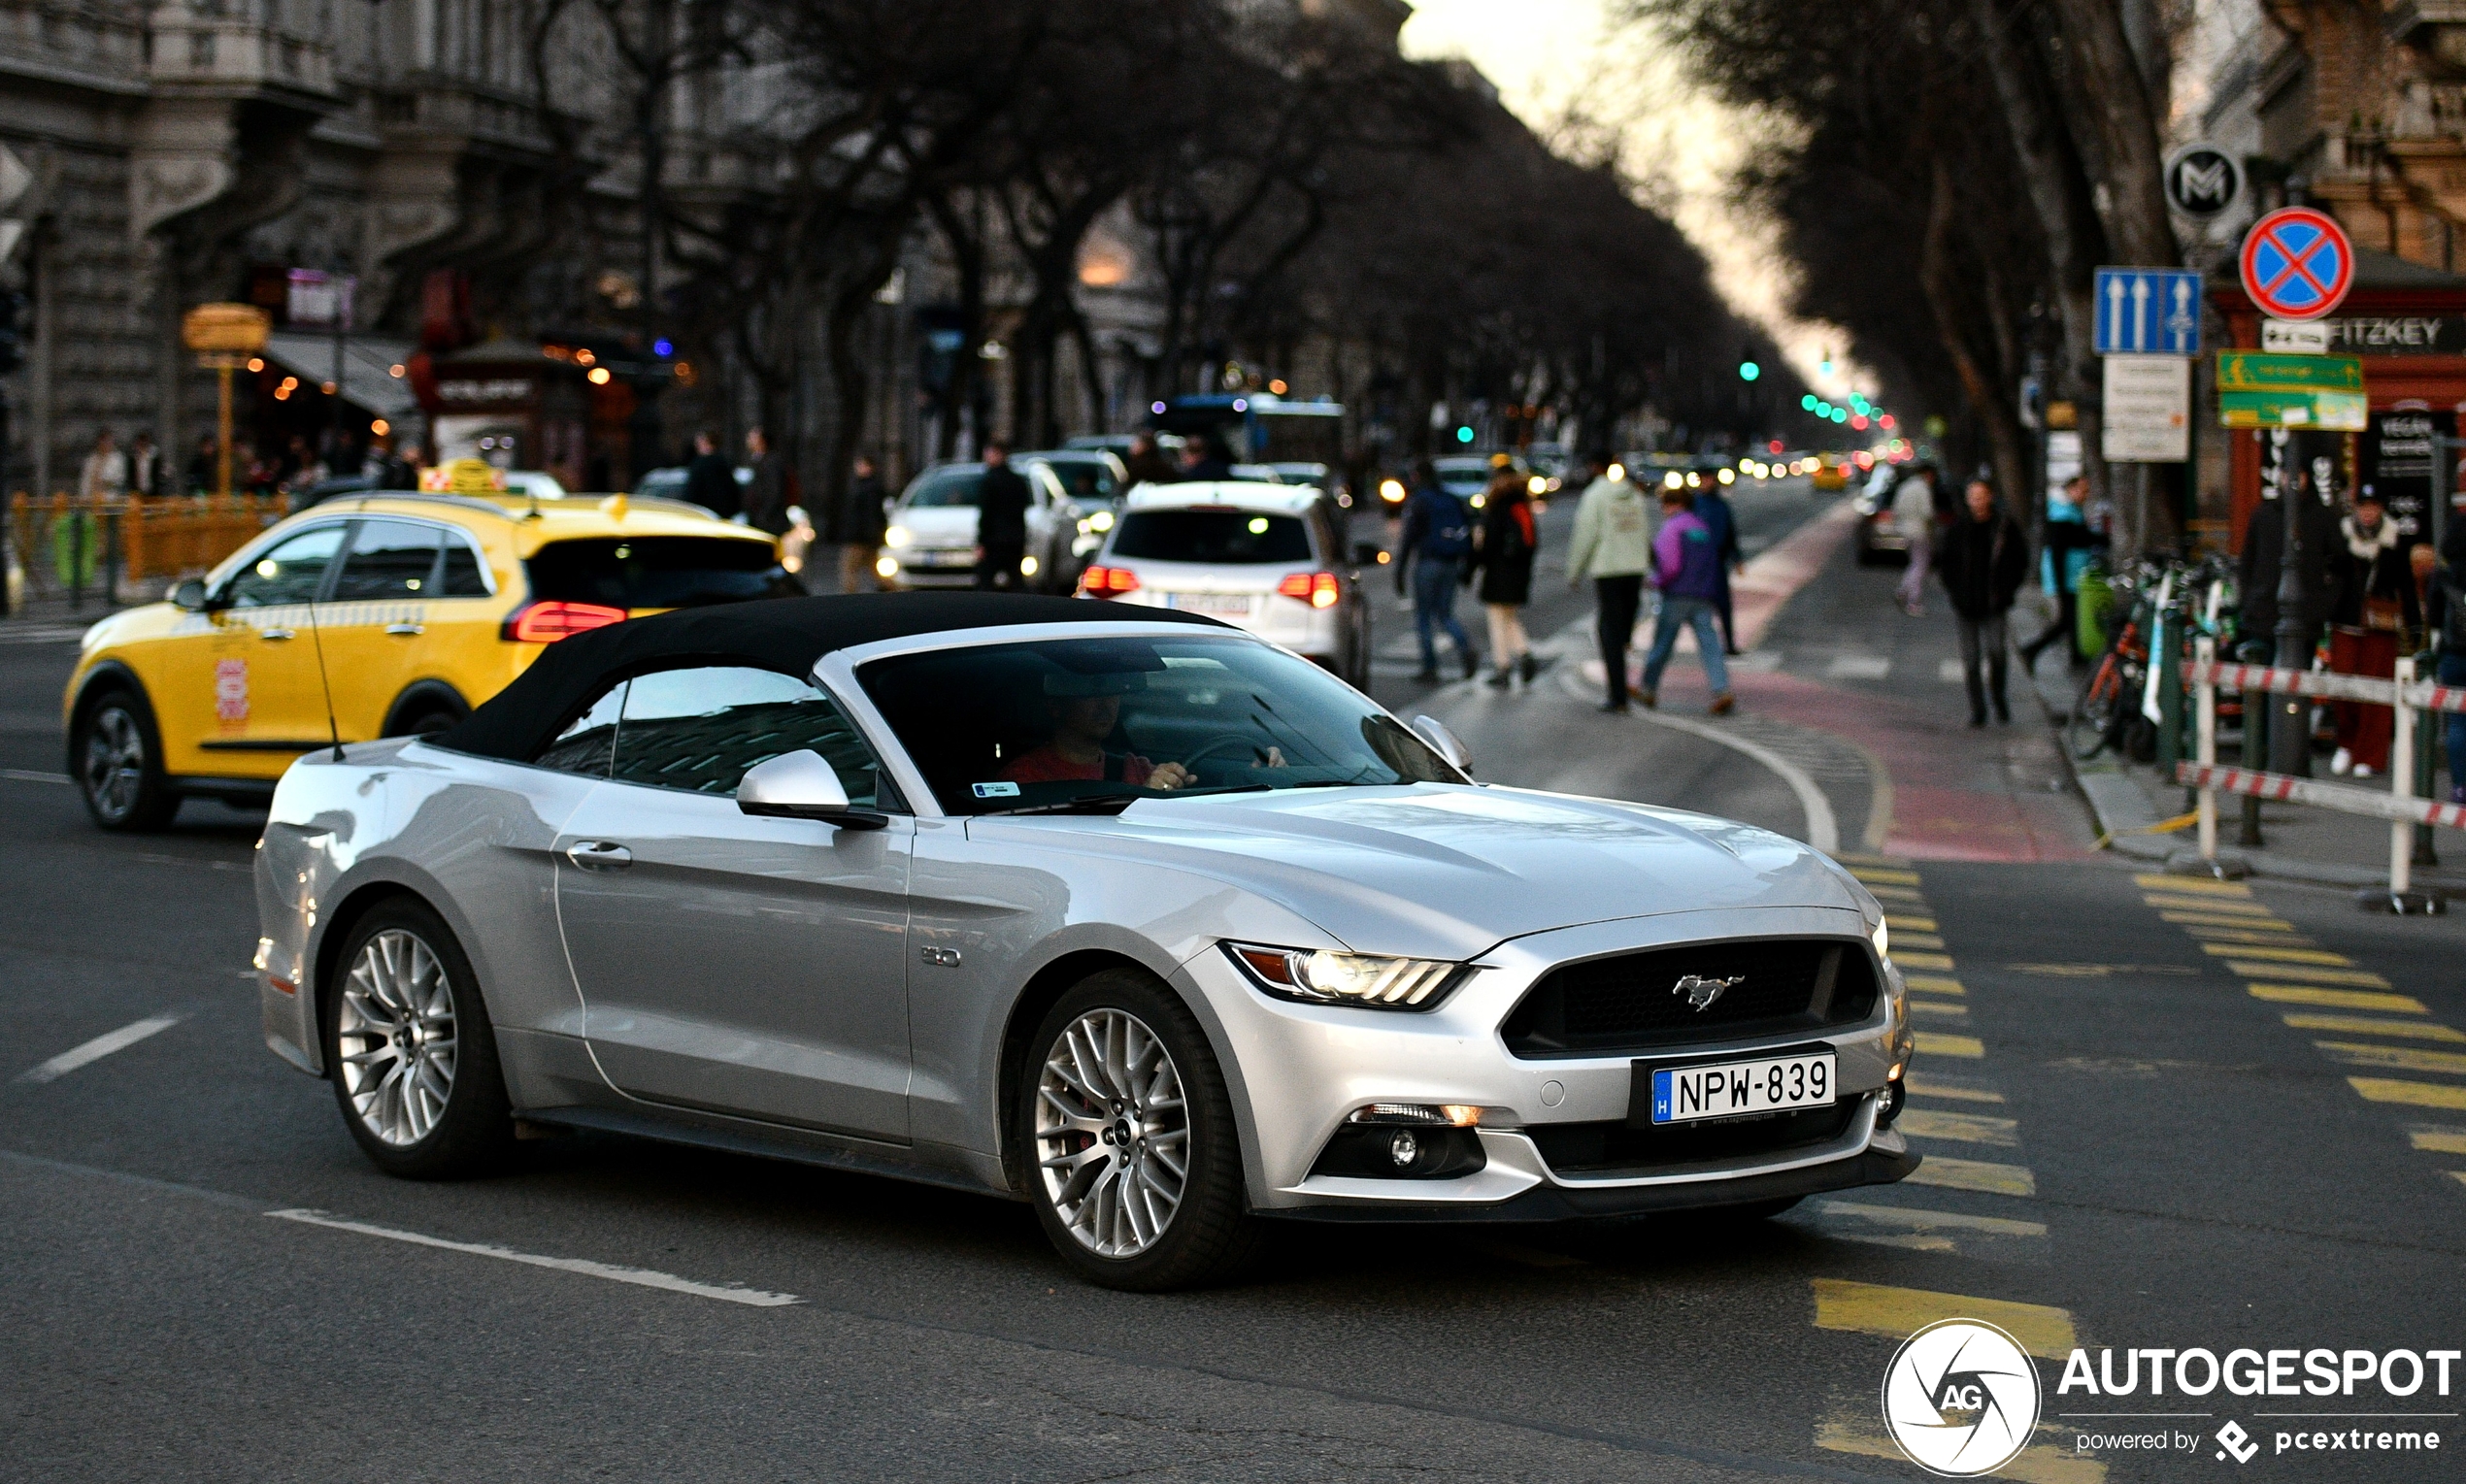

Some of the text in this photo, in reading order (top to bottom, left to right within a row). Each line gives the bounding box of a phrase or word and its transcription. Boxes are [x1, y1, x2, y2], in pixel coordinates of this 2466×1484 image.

[2328, 316, 2443, 346] FITZKEY
[1657, 1060, 1827, 1114] H NPW-839
